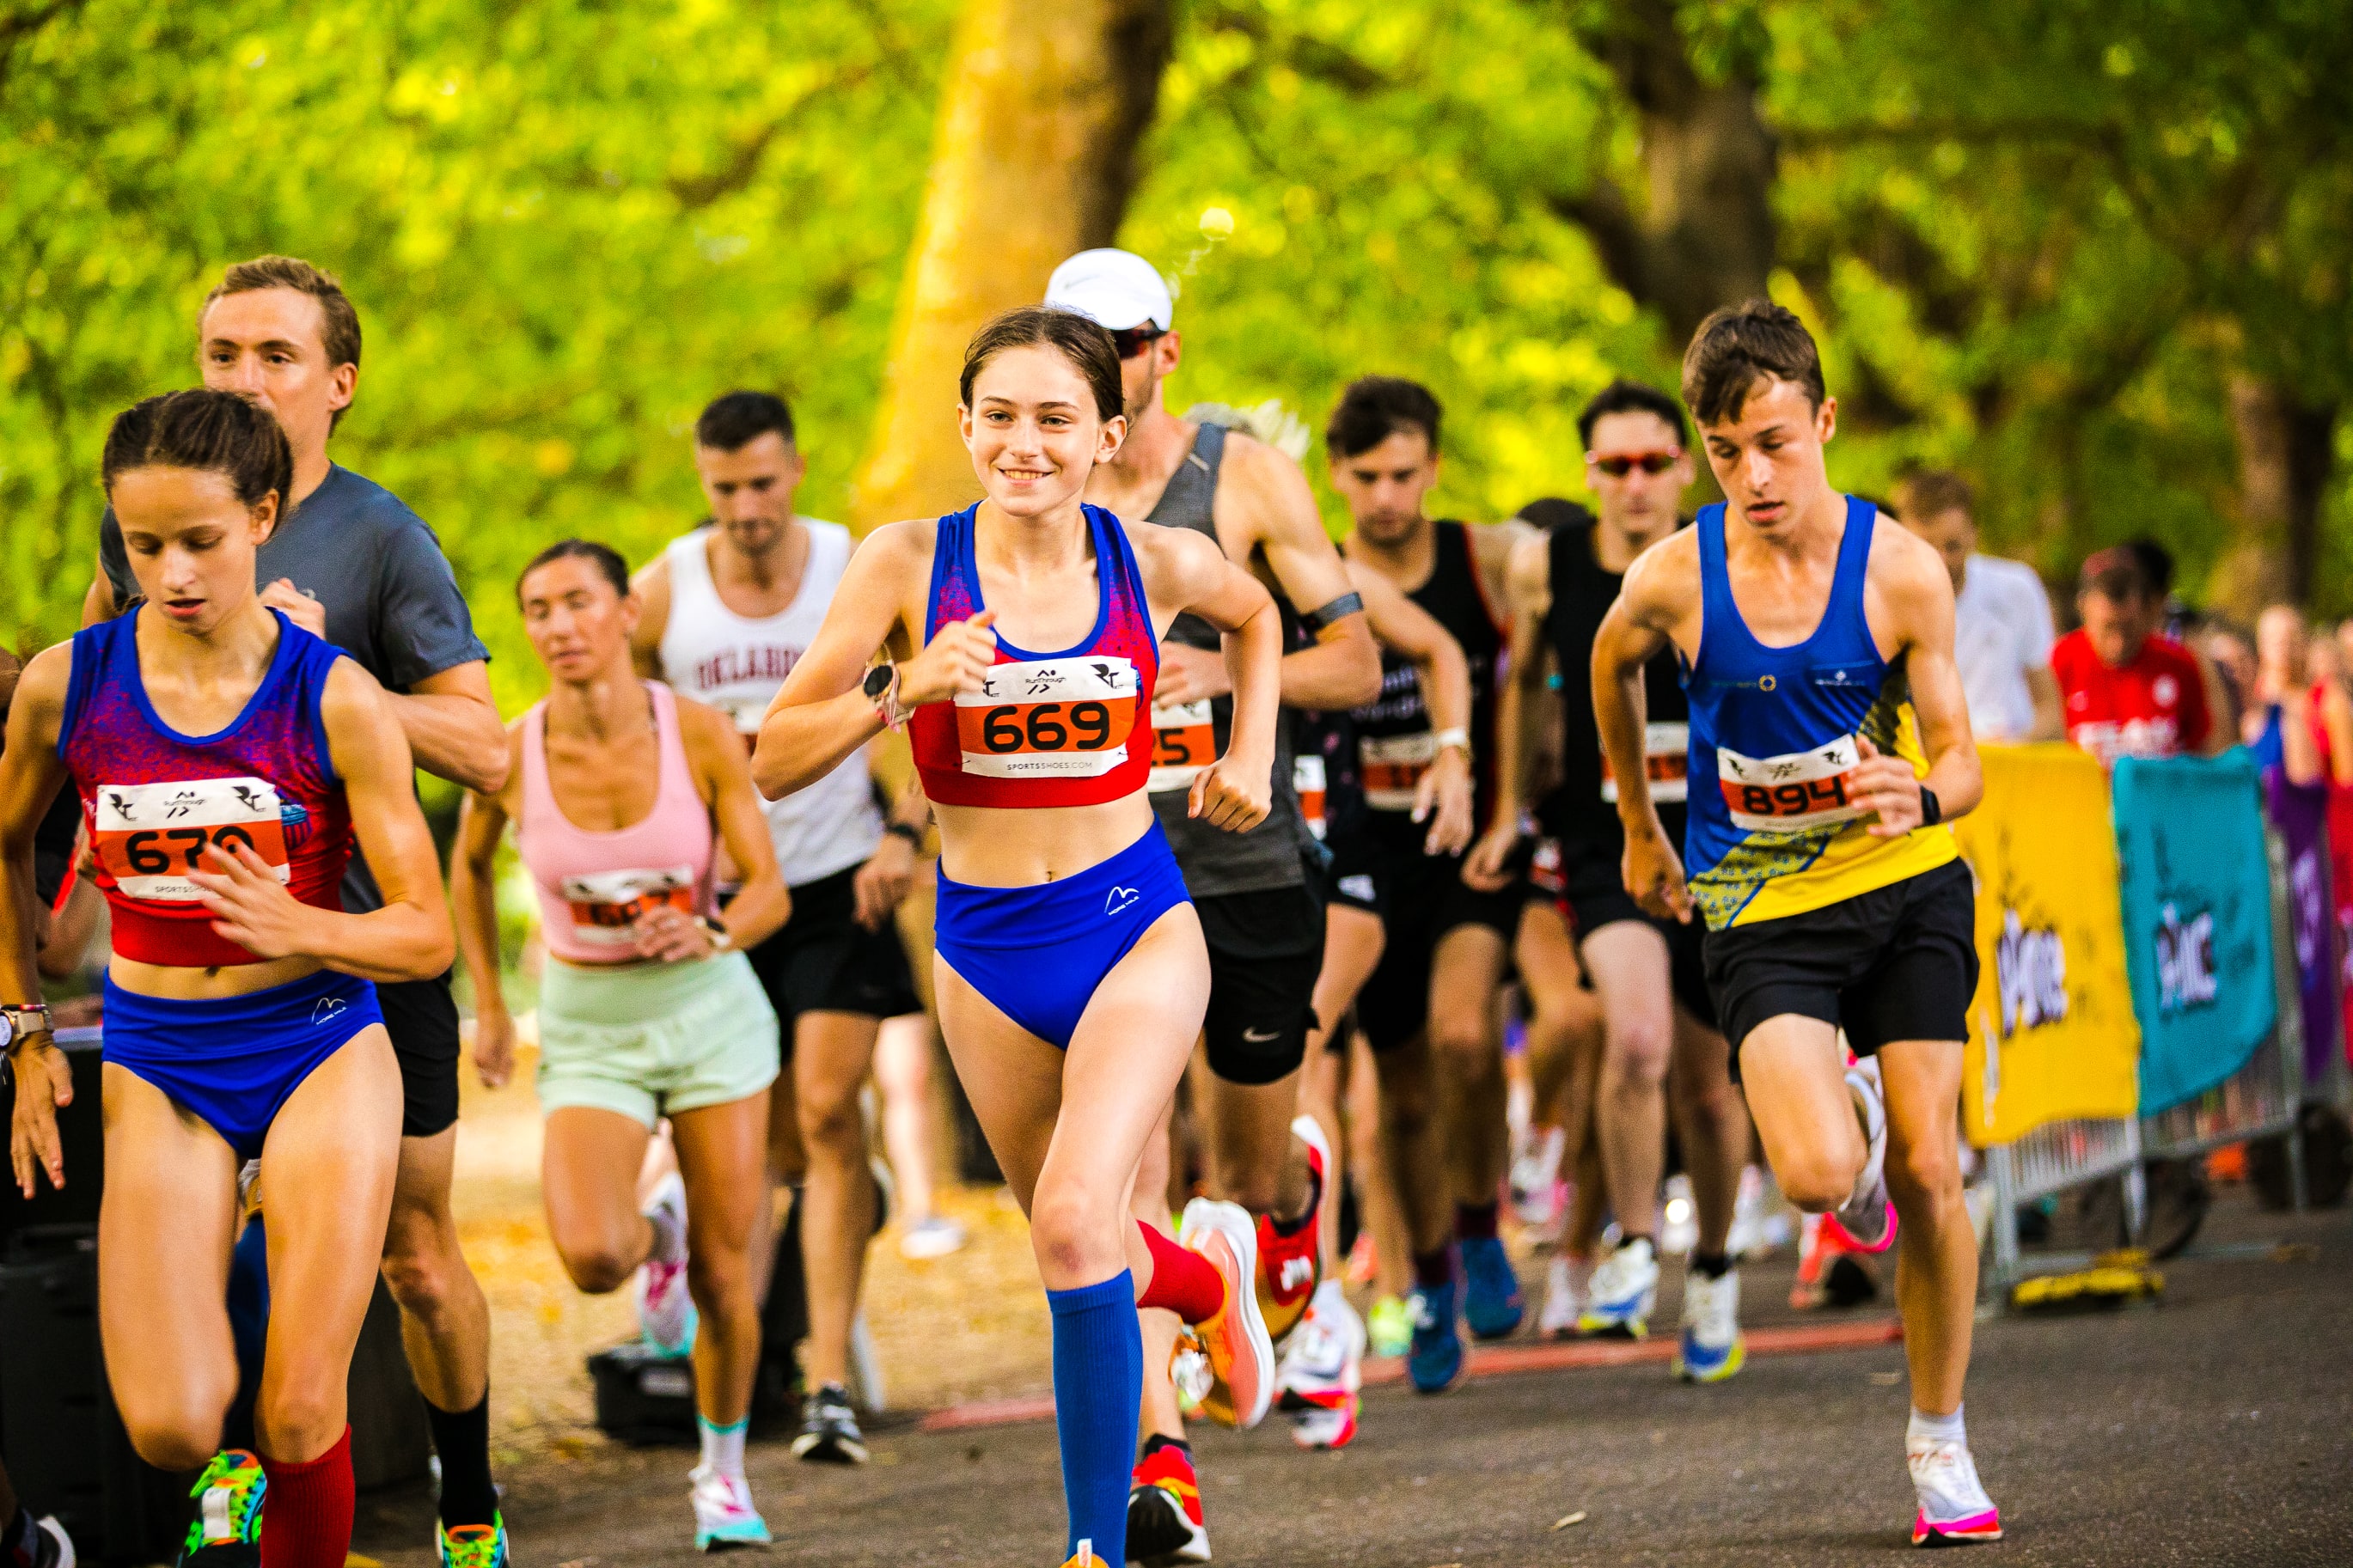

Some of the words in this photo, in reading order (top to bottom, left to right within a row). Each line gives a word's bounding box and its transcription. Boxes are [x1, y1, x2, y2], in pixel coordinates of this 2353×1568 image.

[983, 701, 1110, 753] 669
[1151, 727, 1191, 766] 5
[1007, 761, 1092, 771] SPORTSSHOES.COM
[1743, 775, 1847, 816] 894
